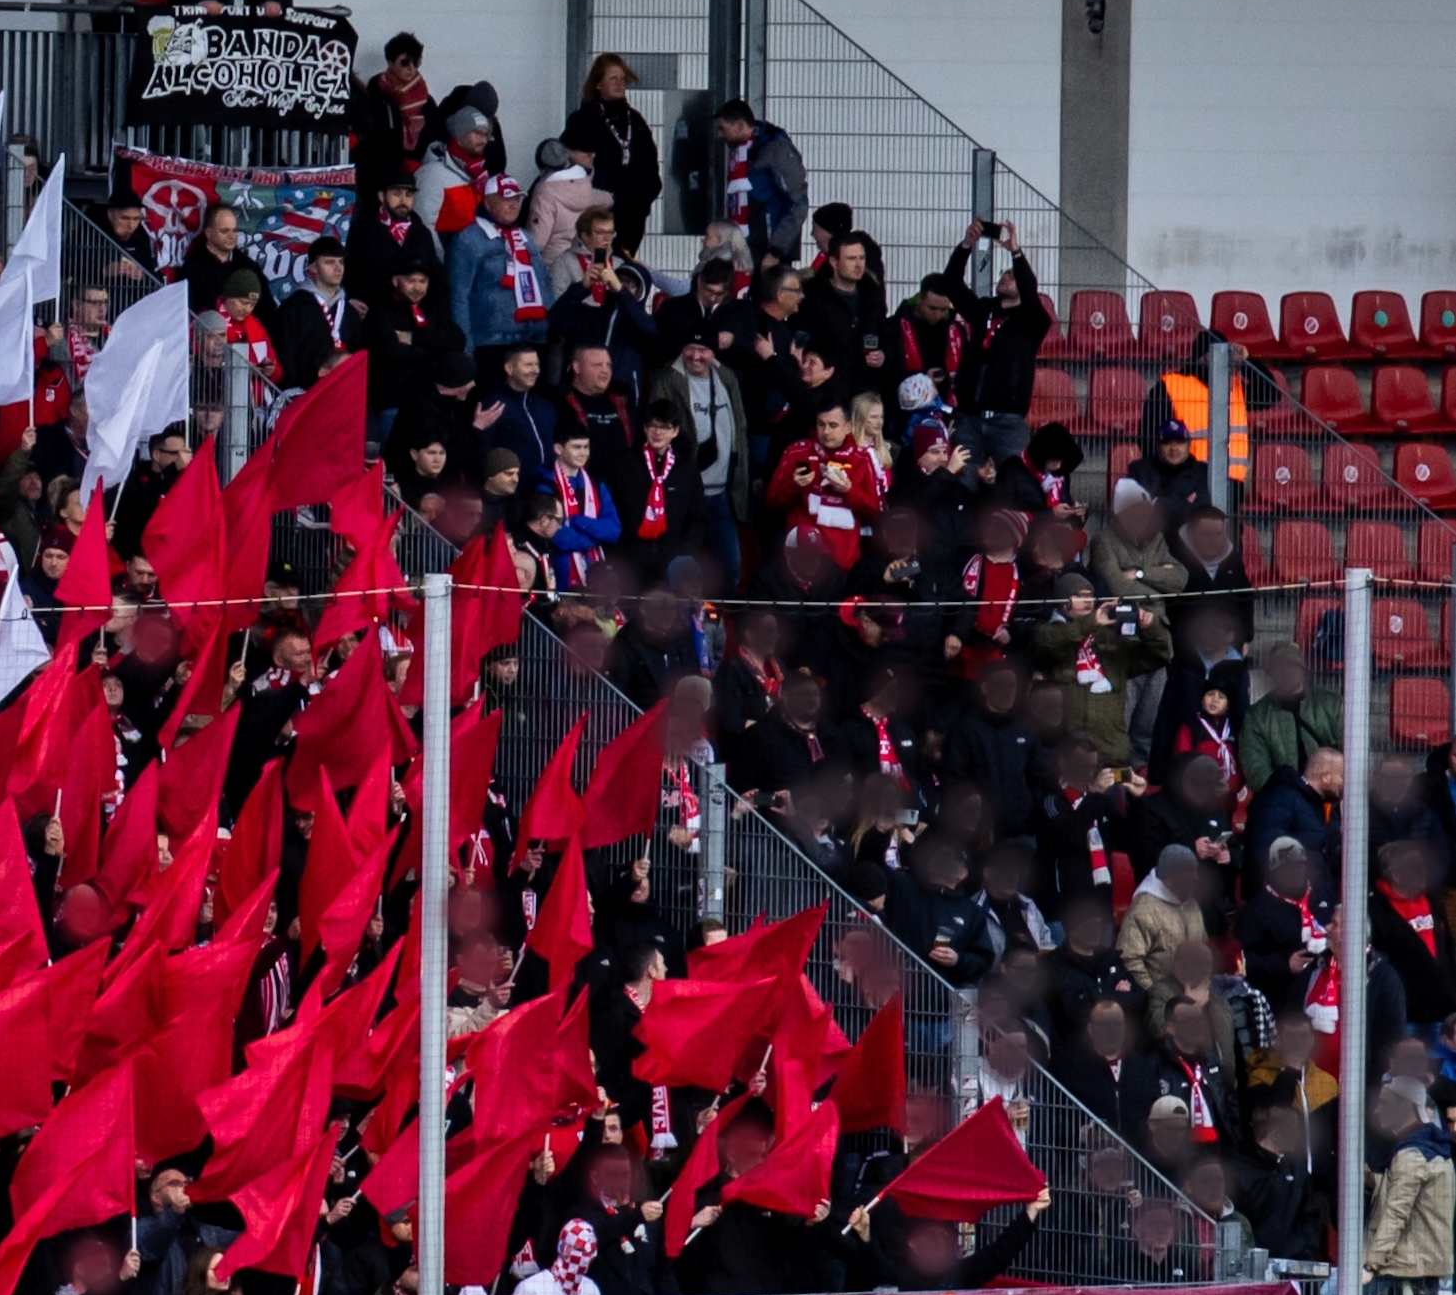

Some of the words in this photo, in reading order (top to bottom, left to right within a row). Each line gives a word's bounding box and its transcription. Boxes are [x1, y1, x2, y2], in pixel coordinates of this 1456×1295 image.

[285, 7, 337, 29] SUPPORT
[205, 25, 321, 64] BANDA
[141, 59, 350, 99] ALCOHOLICA
